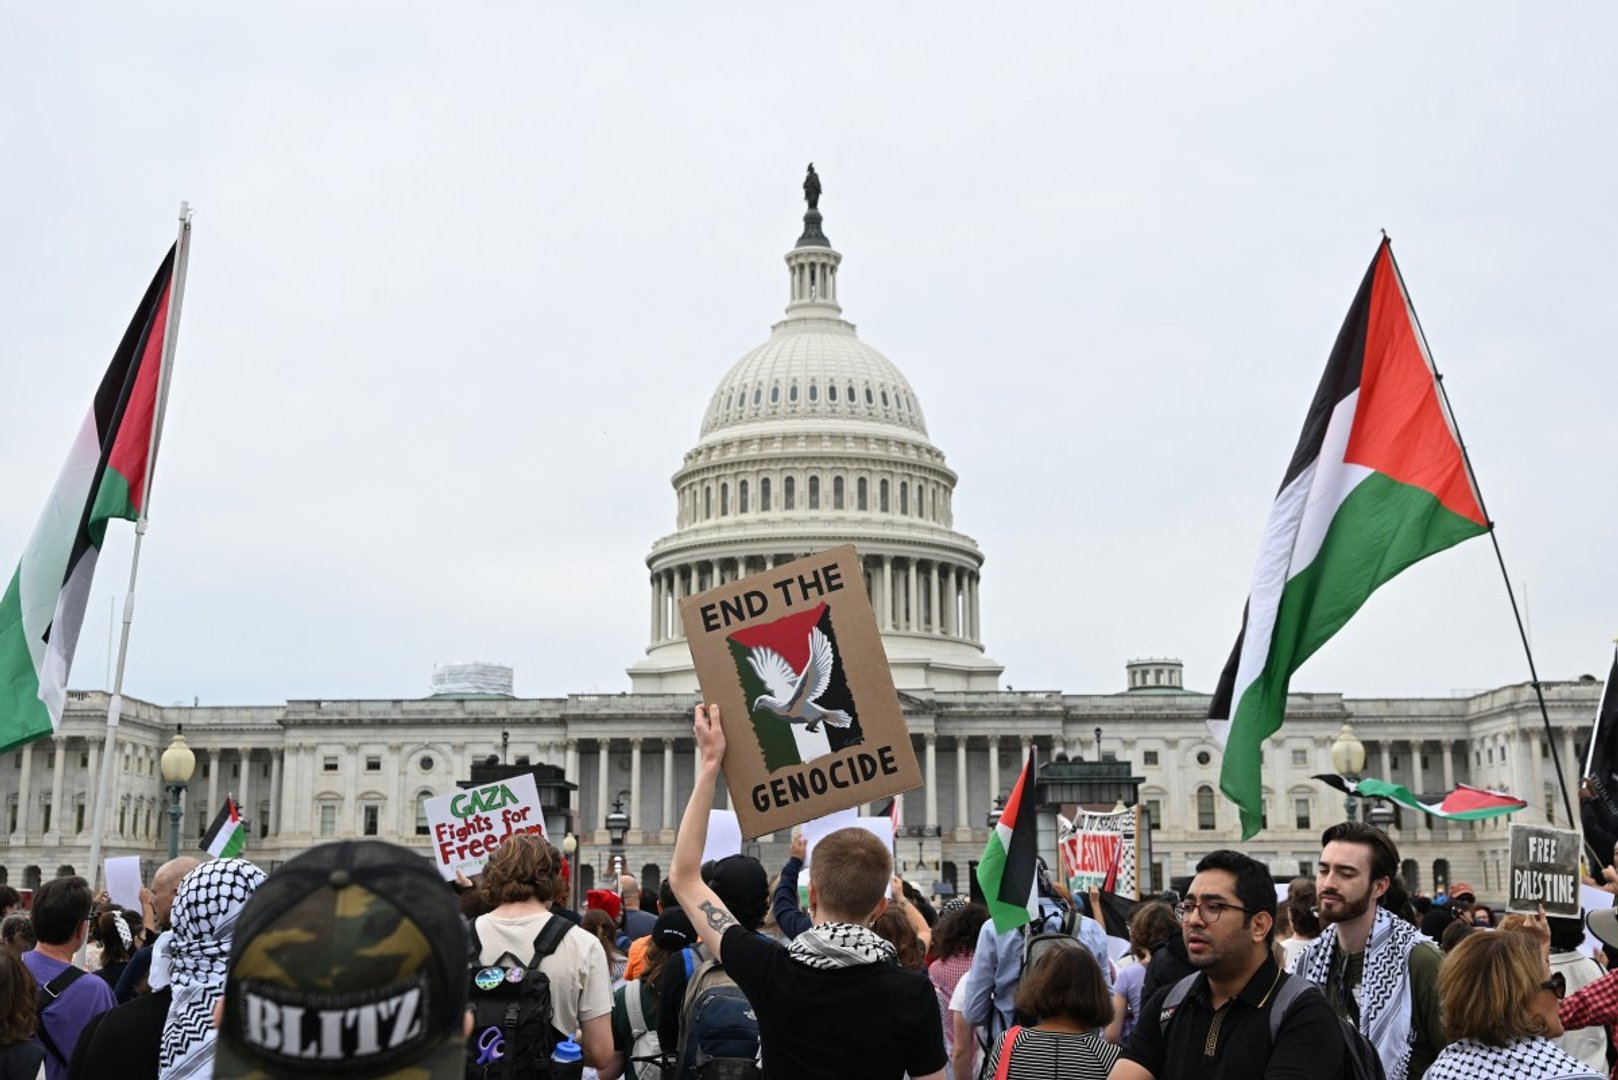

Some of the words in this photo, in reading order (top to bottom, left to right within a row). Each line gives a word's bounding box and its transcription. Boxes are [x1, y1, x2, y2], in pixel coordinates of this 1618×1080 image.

[700, 589, 769, 633] END
[773, 563, 844, 607] THE
[752, 745, 898, 813] GENOCIDE
[450, 783, 519, 818] GAZA
[435, 814, 493, 842] Fights
[501, 806, 531, 824] for
[1528, 837, 1557, 864] FREE
[1514, 869, 1575, 904] PALESTINE
[245, 987, 421, 1060] BLITZ
